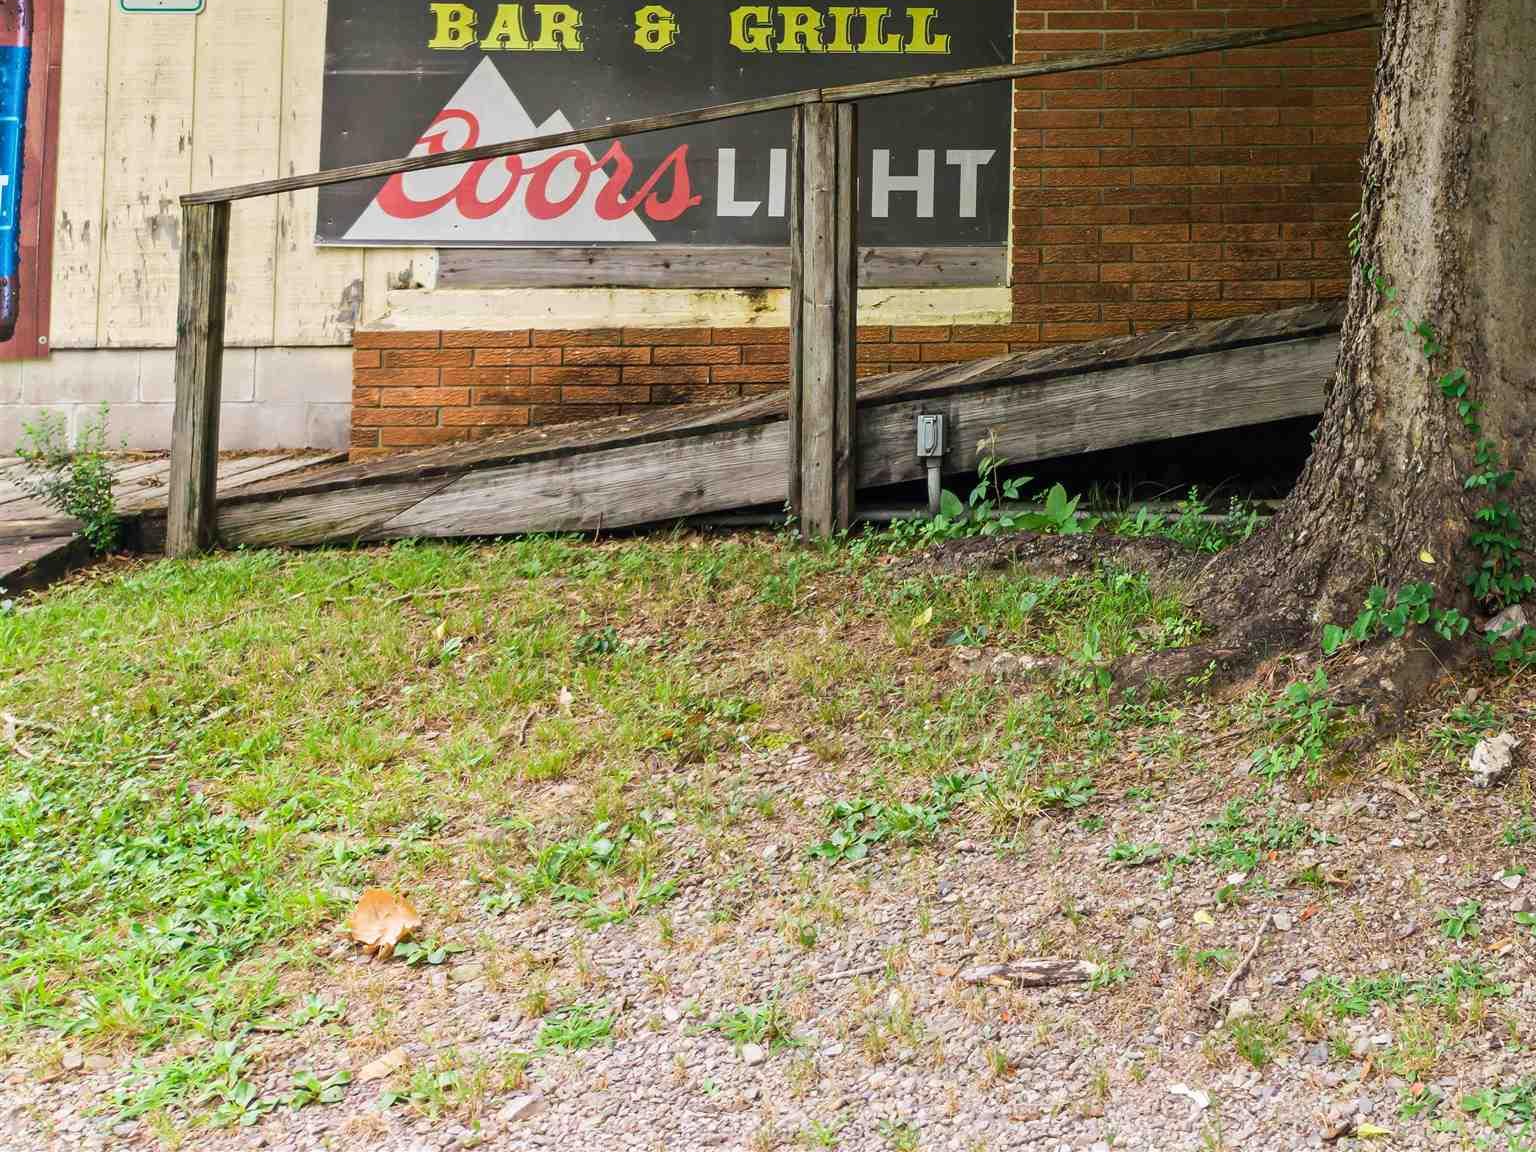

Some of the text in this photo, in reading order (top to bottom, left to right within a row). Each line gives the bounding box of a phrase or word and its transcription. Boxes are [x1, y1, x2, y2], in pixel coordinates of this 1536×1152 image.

[427, 3, 952, 55] BAR & GRILL
[377, 108, 997, 223] Coors LIHT
